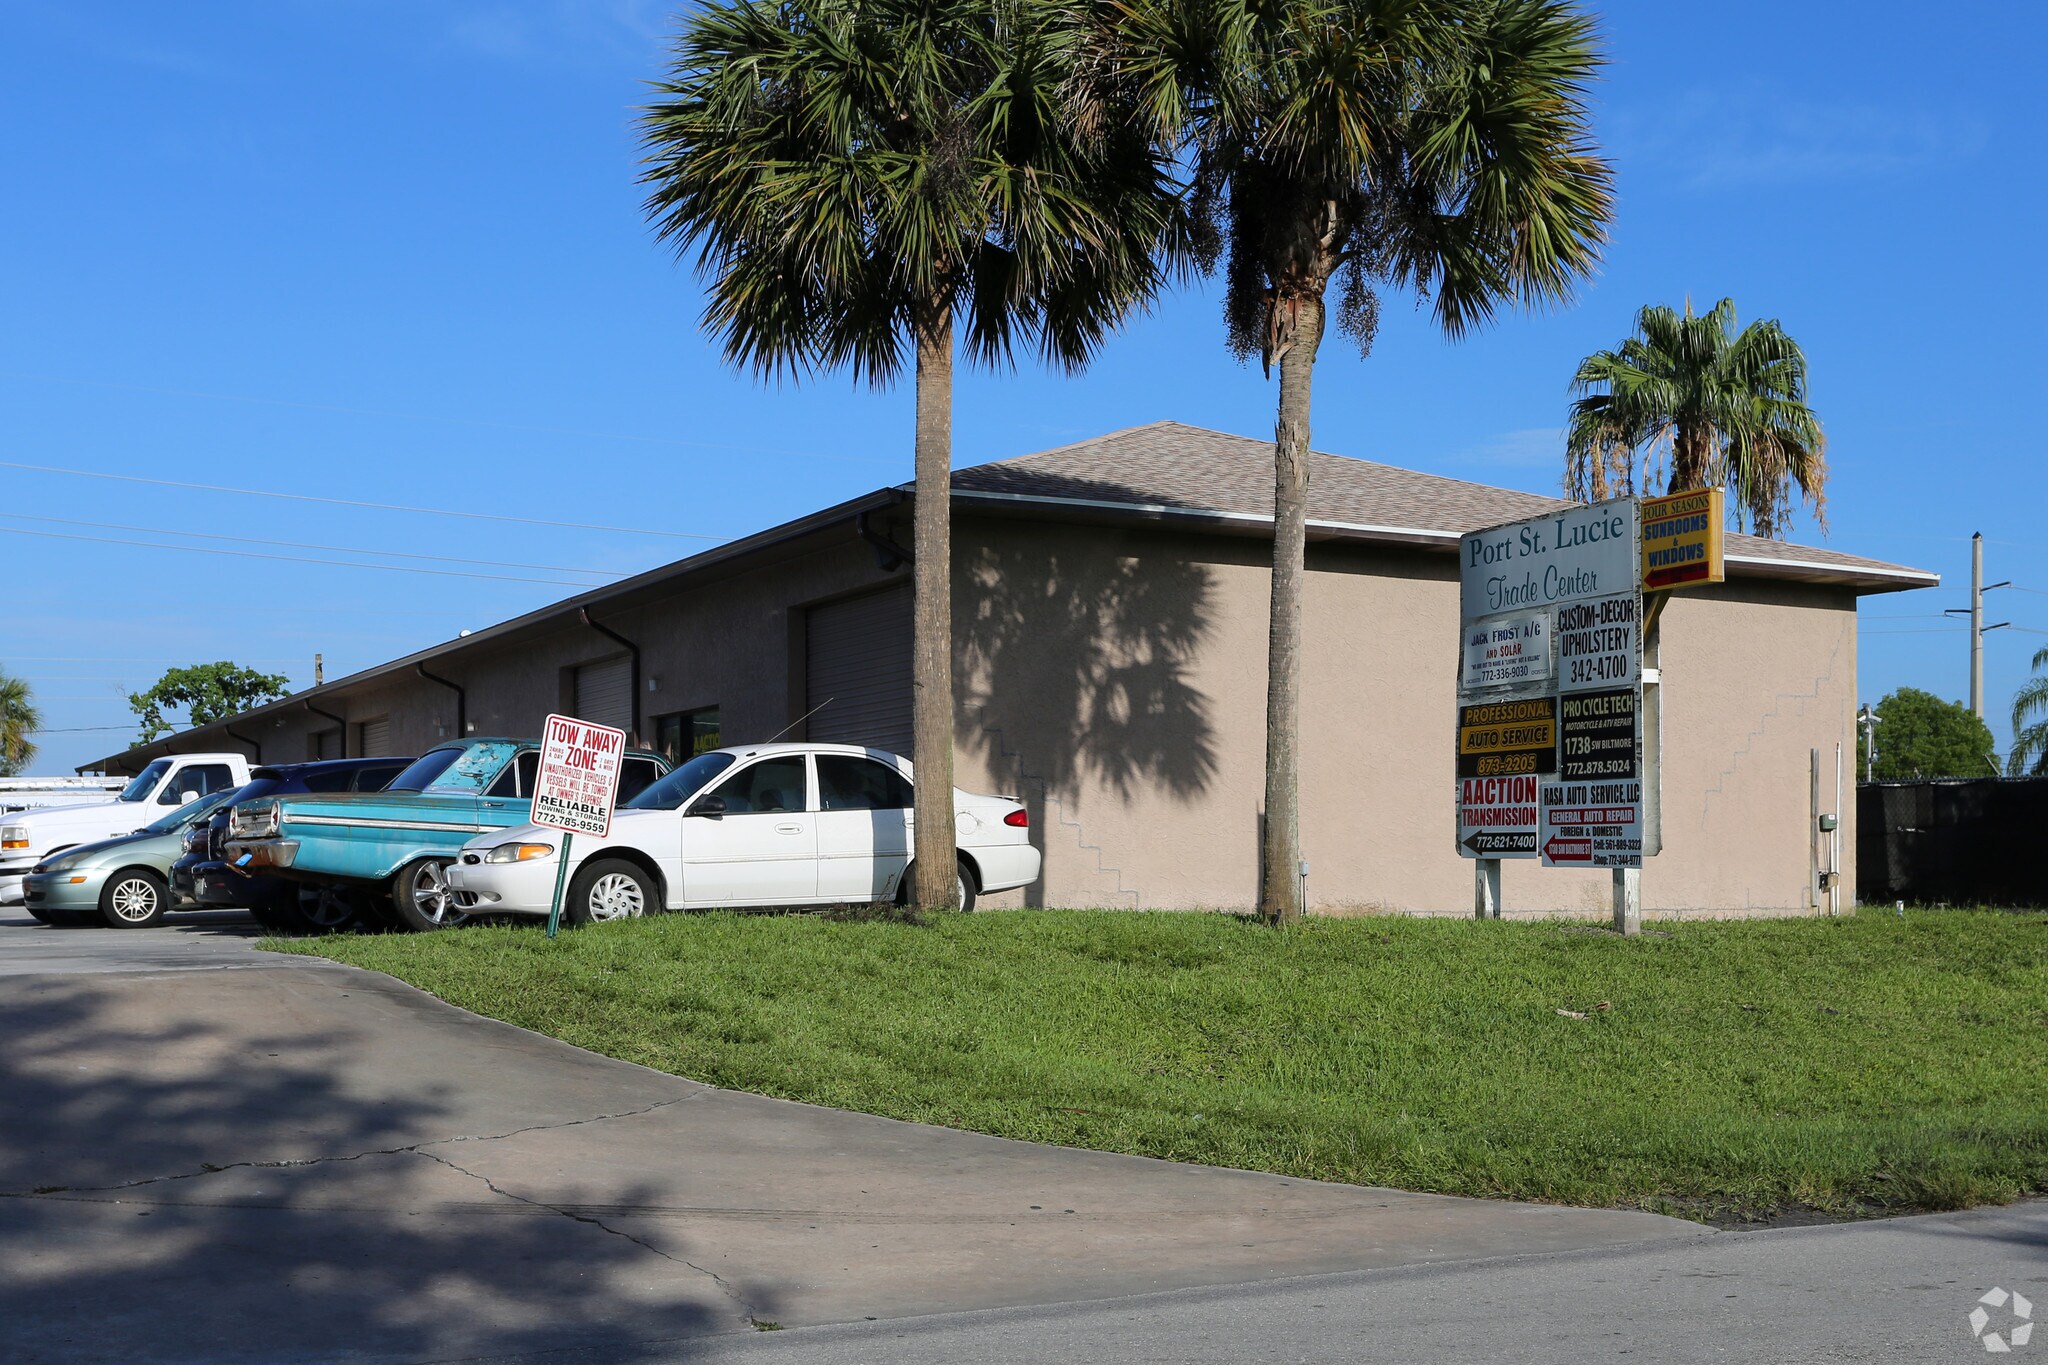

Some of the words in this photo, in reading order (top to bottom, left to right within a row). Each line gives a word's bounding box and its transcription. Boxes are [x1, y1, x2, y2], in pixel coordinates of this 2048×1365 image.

[1644, 504, 1667, 519] FOUR
[1671, 495, 1709, 514] SEASONS
[1469, 538, 1512, 568] Port
[1520, 527, 1546, 556] St.
[1555, 509, 1624, 549] Lucie
[1645, 514, 1708, 541] SUNROOMS
[1673, 538, 1678, 546] &
[1648, 543, 1704, 567] WINDOWS
[1487, 572, 1538, 610] Trade
[1544, 565, 1598, 600] Center
[1559, 599, 1634, 632] CUSTOM-DECOR
[1471, 633, 1488, 646] JACK
[1493, 626, 1519, 642] FROST
[1524, 621, 1540, 638] A/C
[1562, 627, 1630, 657] UPHOLSTERY
[1486, 648, 1497, 659] AND
[1500, 643, 1522, 657] SOLAR
[1482, 665, 1528, 681] 772-336-9030
[1571, 654, 1627, 683] 342-4700
[1465, 701, 1552, 725] PROFESSIONAL
[1564, 700, 1580, 718] PRO
[1583, 697, 1609, 716] CYCLE
[1610, 695, 1633, 713] TECH
[1565, 720, 1598, 730] MOTORCYCLE
[1603, 719, 1613, 728] ATV
[1614, 717, 1632, 727] REPAIR
[552, 721, 580, 745] TOW
[583, 729, 619, 754] AWAY
[1466, 729, 1500, 749] AUTO
[1502, 725, 1549, 746] SERVICE
[1565, 736, 1590, 755] 1738
[1592, 740, 1600, 750] SW
[1602, 738, 1632, 749] BILTMORE
[565, 746, 598, 771] ZONE
[1477, 753, 1537, 775] 873-2205
[1567, 760, 1630, 775] 772.878.5024
[545, 762, 582, 779] UNAUTHORIZED
[585, 771, 606, 785] VEHICLES
[546, 774, 567, 787] VESSELS
[569, 780, 580, 791] WILL
[583, 782, 589, 793] BE
[591, 784, 608, 796] TOWED
[548, 786, 555, 796] AT
[556, 788, 579, 801] OWNER'S
[581, 794, 603, 807] EXPENSE
[1462, 777, 1536, 805] AACTION
[1544, 787, 1563, 806] RASA
[1567, 786, 1587, 805] AUTO
[1627, 783, 1639, 803] LLC
[538, 803, 565, 815] TOWING
[575, 811, 606, 823] STORAGE
[540, 796, 606, 816] RELIABLE
[1462, 807, 1536, 826] TRANSMISSION
[1552, 811, 1581, 823] GENERAL
[1584, 810, 1603, 822] AUTO
[1606, 810, 1633, 821] REPAIR
[537, 812, 604, 833] 772-785-9559
[1561, 827, 1584, 836] FOREIGN
[1586, 828, 1590, 836] &
[1593, 826, 1622, 836] DOMESTIC
[1477, 836, 1535, 848] 772-621-7400
